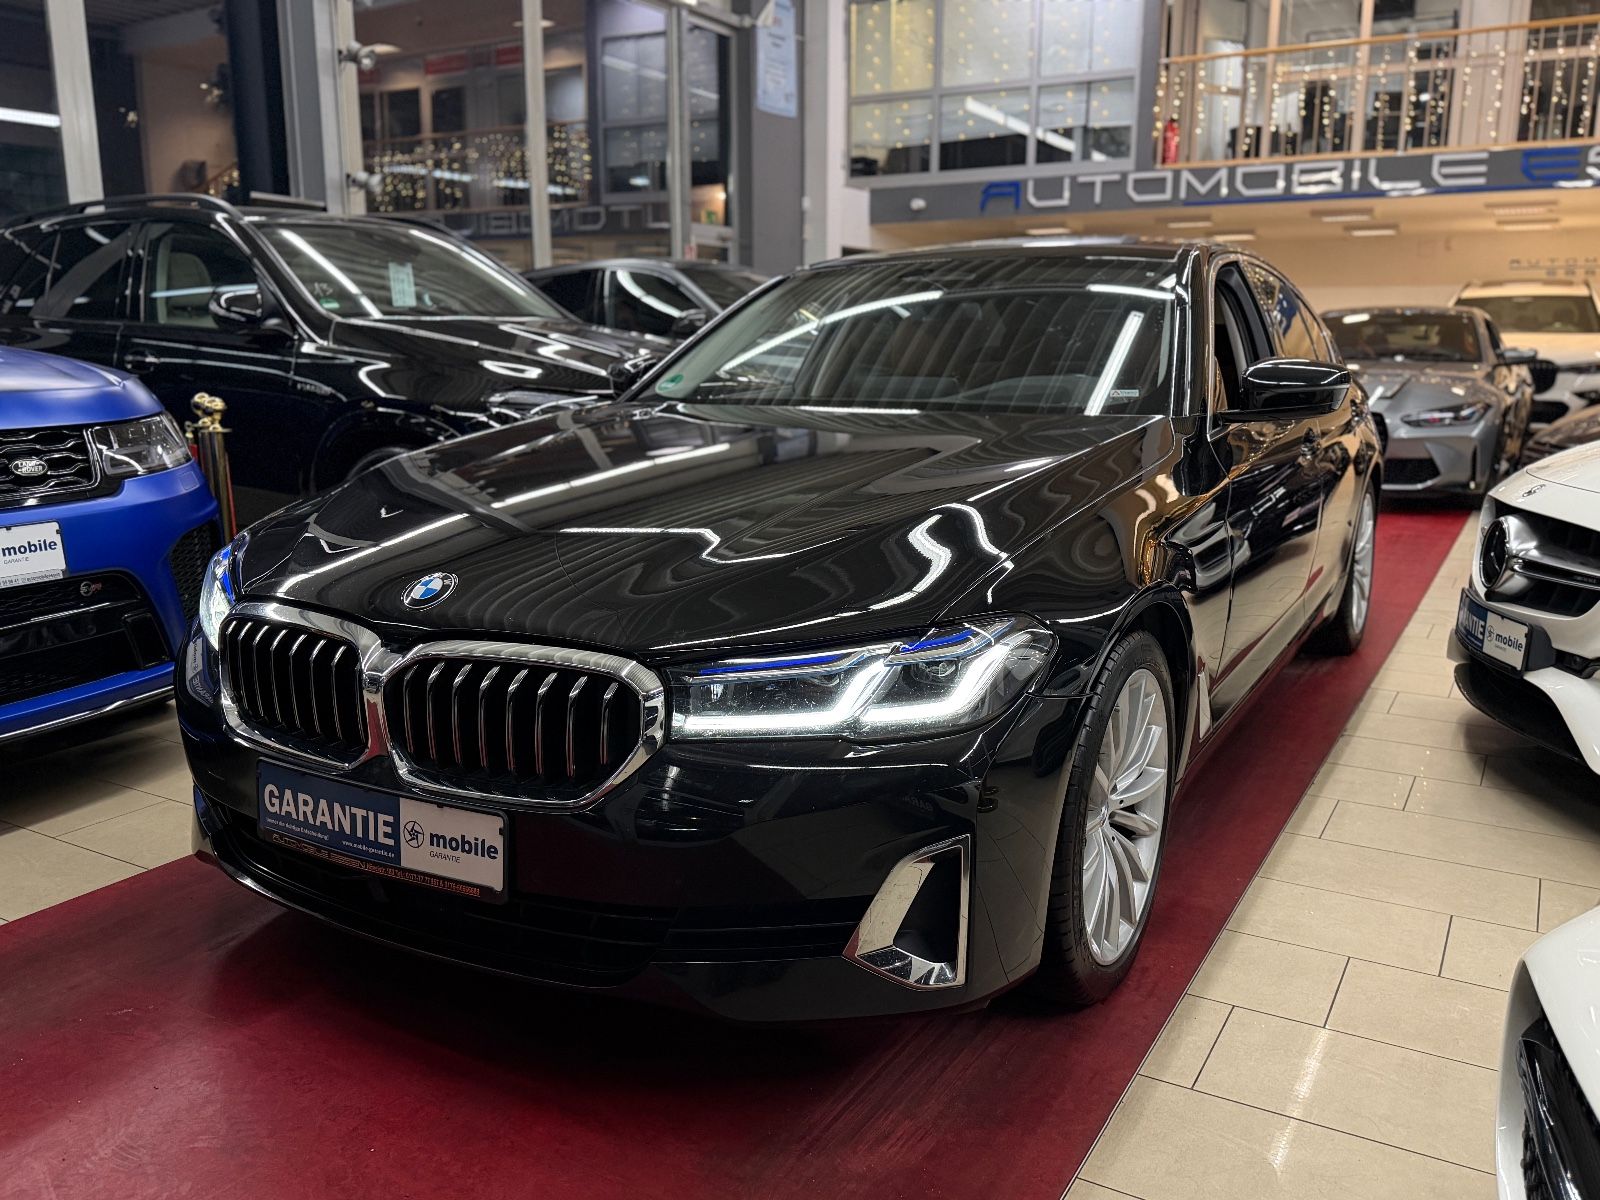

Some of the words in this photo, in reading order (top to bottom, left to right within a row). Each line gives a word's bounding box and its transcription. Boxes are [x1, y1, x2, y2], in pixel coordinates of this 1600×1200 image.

[980, 151, 1490, 211] AUTOMOBILE
[1, 539, 57, 557] mobile
[1495, 633, 1523, 652] mobile
[263, 783, 395, 846] GARANTIE
[429, 829, 499, 860] mobile
